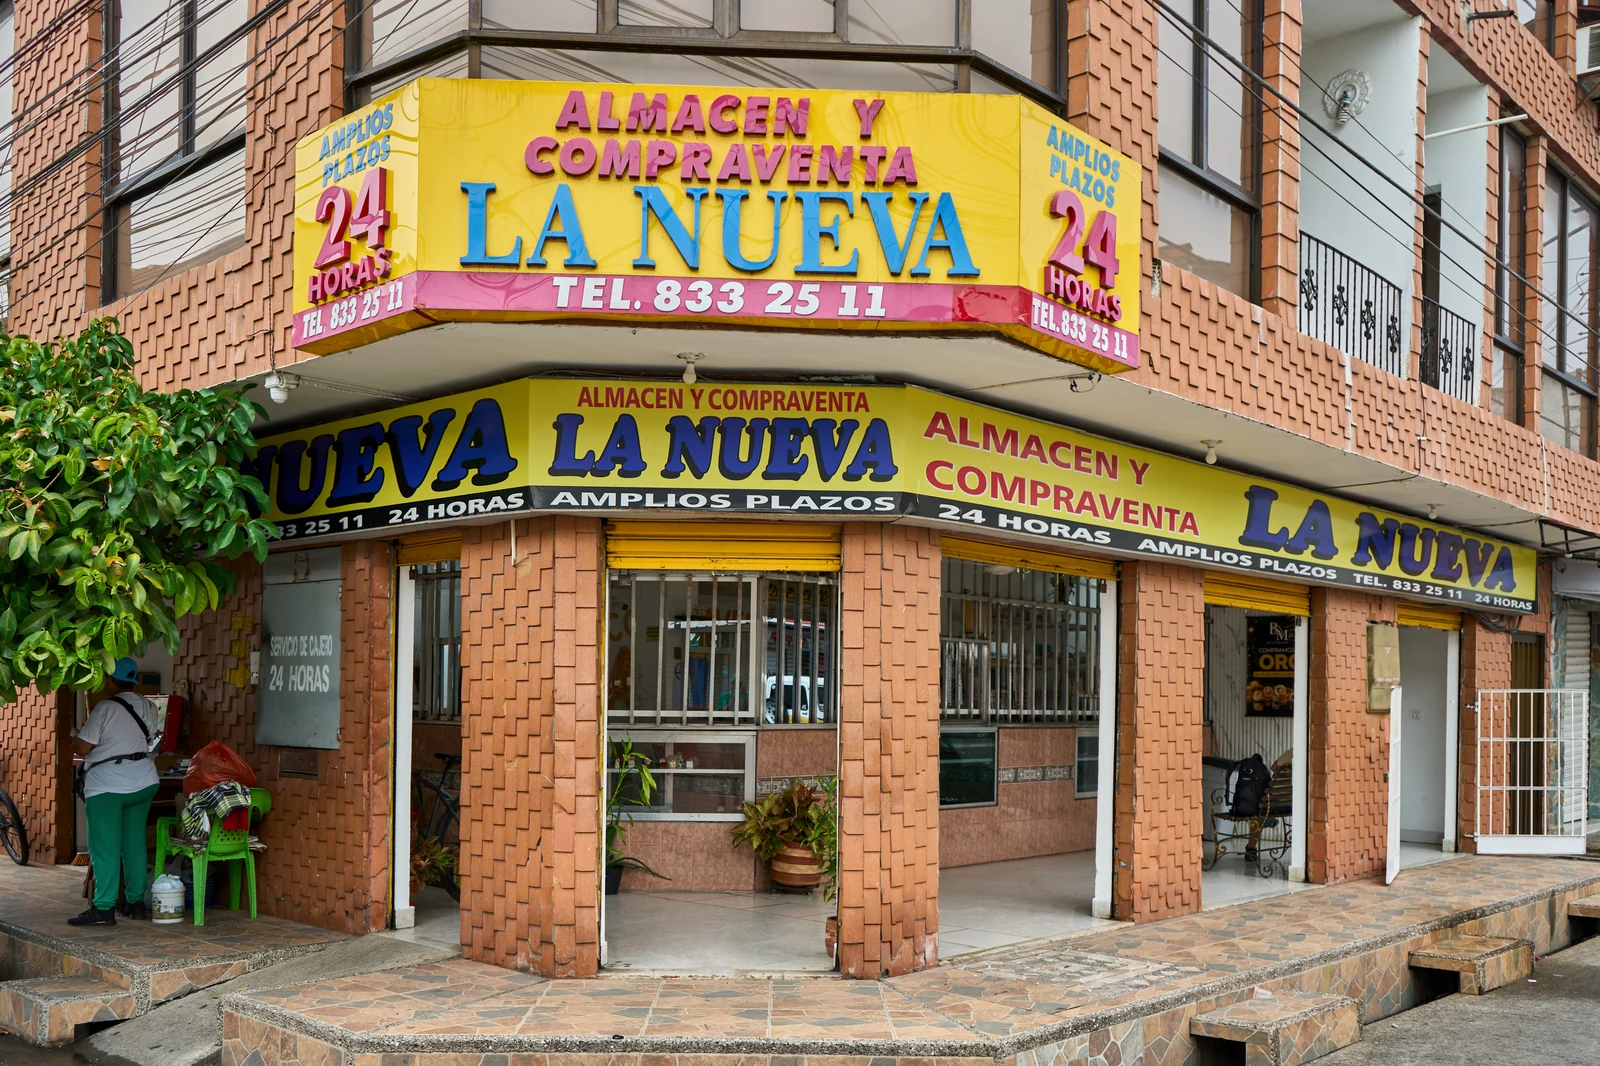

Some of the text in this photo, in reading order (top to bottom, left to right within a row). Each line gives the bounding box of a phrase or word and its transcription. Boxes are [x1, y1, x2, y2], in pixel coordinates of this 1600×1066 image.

[319, 102, 394, 161] AMPLIOS
[555, 90, 886, 139] ALMACEN Y
[322, 135, 391, 188] PLAZOS
[524, 136, 918, 185] COMPRAVENTA
[1045, 124, 1121, 182] AMPLIOS
[1049, 159, 1116, 209] PLAZOS
[314, 166, 391, 270] 24
[459, 182, 980, 278] LA NUEVA
[1048, 190, 1120, 290] 24
[308, 247, 393, 304] HORAS
[553, 276, 887, 318] TEL. 833 25 11
[1044, 264, 1123, 323] HORAS
[330, 298, 357, 329] 833
[361, 290, 381, 322] 25
[386, 281, 404, 312] 11
[1032, 297, 1128, 359] TEL. 833 25 11
[577, 386, 870, 413] ALMACEN Y COMPRAVENTA
[548, 413, 899, 482] LA NUEVA
[923, 410, 1151, 486] ALMACEN Y
[305, 519, 331, 535] 25
[338, 515, 363, 530] 11
[388, 506, 420, 524] 24
[427, 492, 525, 519] HORAS
[550, 491, 896, 511] AMPLIOS PLAZOS
[924, 459, 1201, 537] COMPRAVENTA
[938, 503, 1533, 611] 24 HORAS AMPLIOS PLAZOS TEL. 833 25 11 24 HORAS
[1238, 485, 1517, 593] LA NUEVA
[270, 634, 333, 657] SERVICIO DE CAJERO
[269, 664, 330, 692] 24 HORAS
